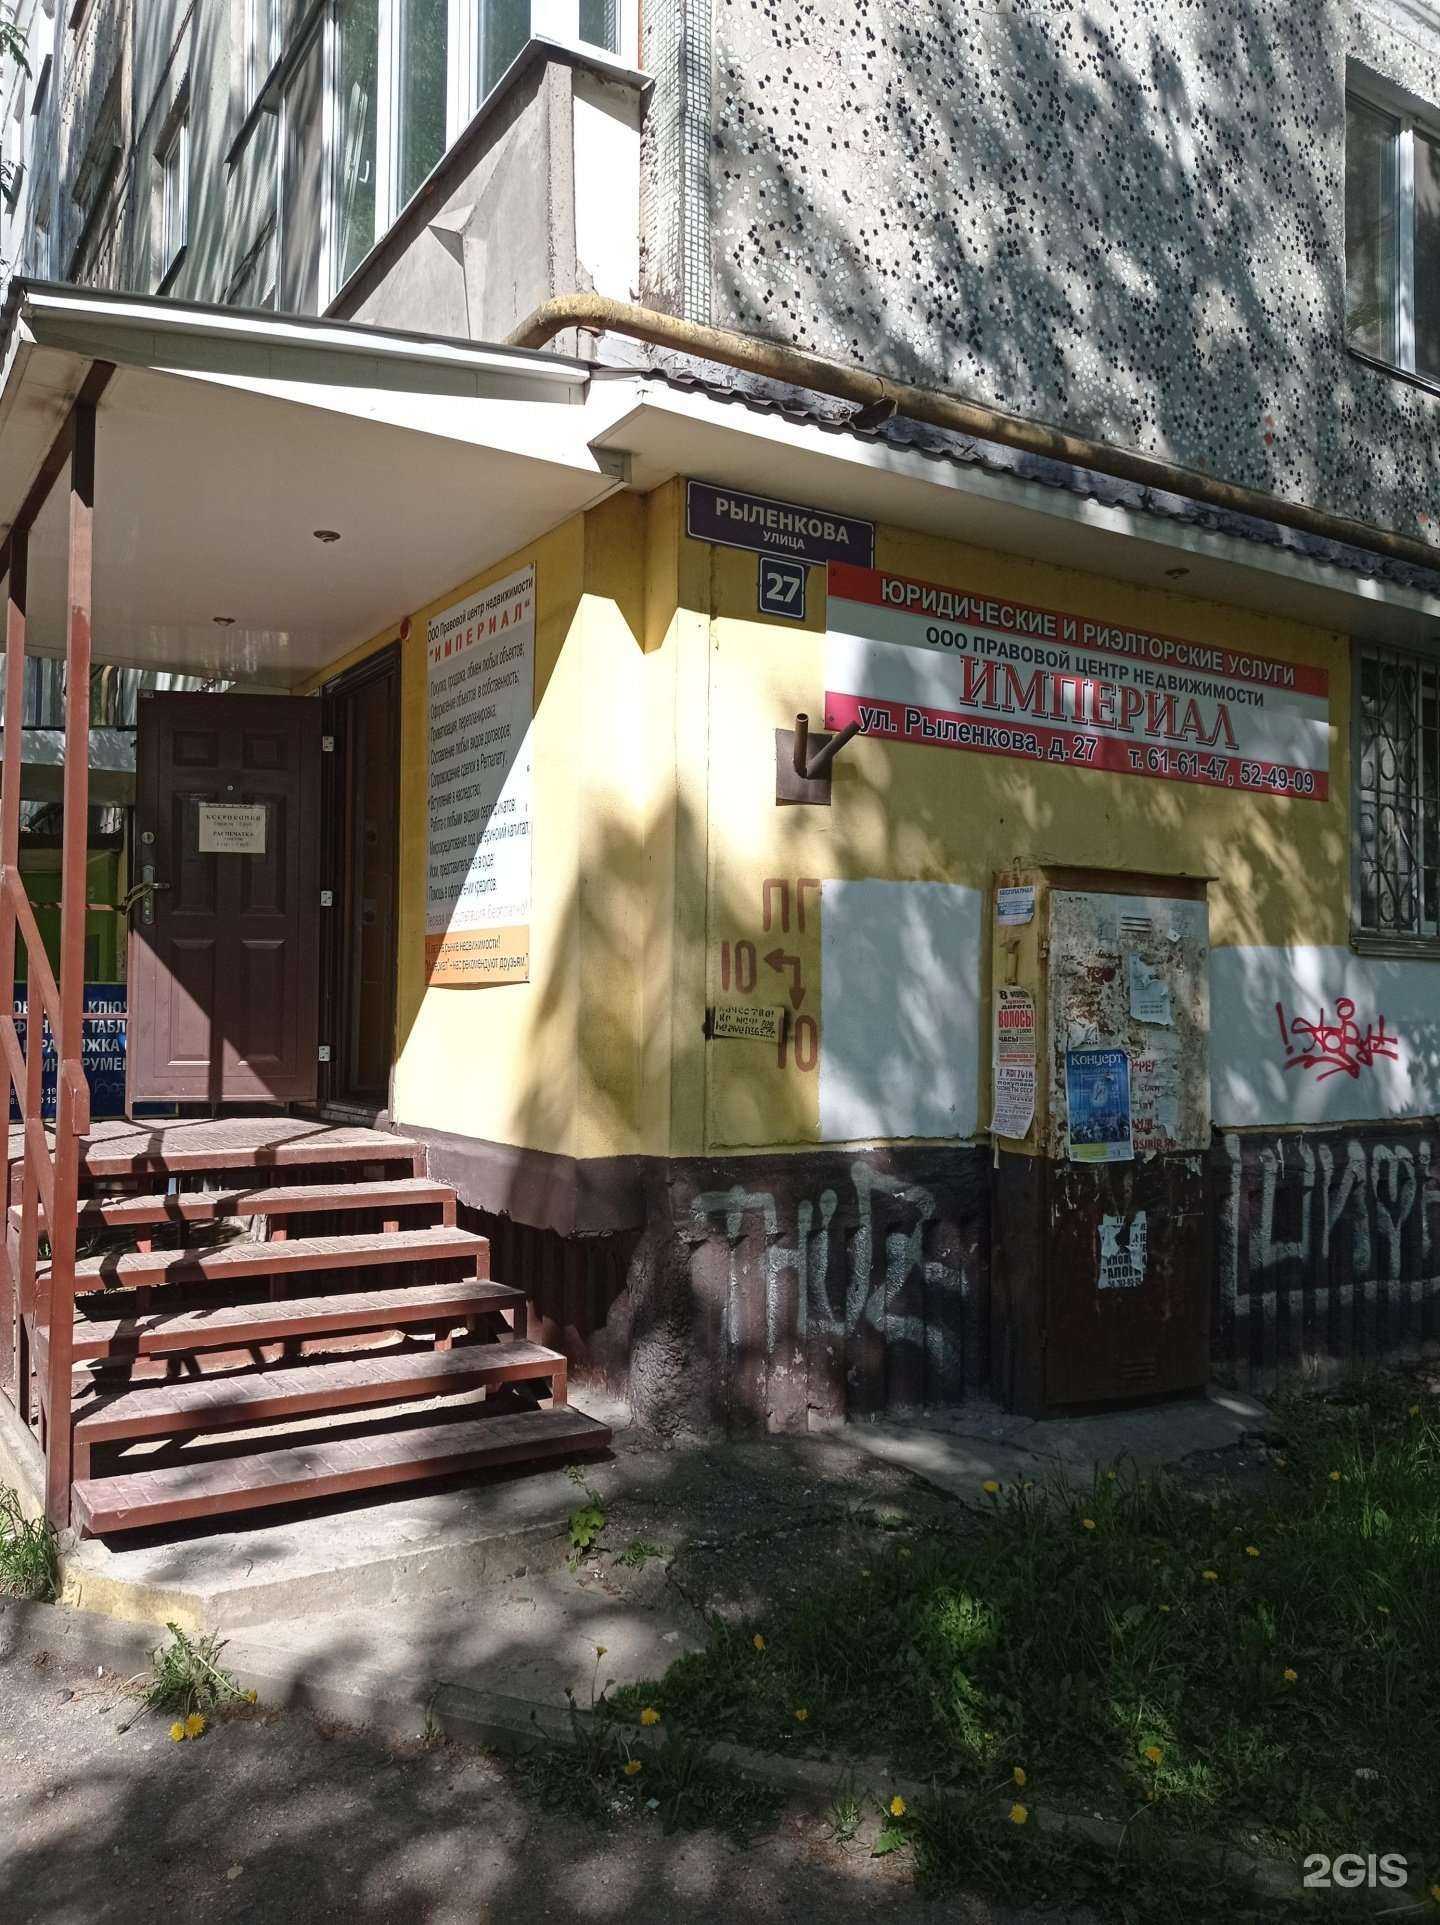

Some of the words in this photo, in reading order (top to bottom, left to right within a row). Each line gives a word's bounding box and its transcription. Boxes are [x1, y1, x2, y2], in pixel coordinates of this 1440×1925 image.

[716, 497, 850, 544] РЫЛЕНКОВА
[762, 530, 805, 550] УЛИЦА
[428, 625, 440, 643] ООО
[440, 612, 466, 639] Правовой
[467, 602, 485, 622] центр
[485, 577, 533, 611] недвижимости
[766, 572, 801, 603] 27
[881, 578, 1057, 637] ЮРИДИЧЕСКИЕ
[1063, 619, 1077, 641] И
[1083, 623, 1223, 673] РИЭЛТОРСКИЕ
[1229, 653, 1295, 687] УСЛУГИ
[926, 626, 968, 650] ООО
[973, 636, 1070, 670] ПРАВОВОЙ
[1075, 655, 1129, 681] ЦЕНТР
[1133, 667, 1264, 707] НЕДВИЖИМОСТИ
[959, 654, 1240, 750] ИМПЕРИАЛ
[858, 705, 897, 734] ул.
[904, 708, 1044, 758] Рыленкова,
[1048, 736, 1069, 762] д.
[1072, 735, 1098, 762] 27
[1128, 749, 1143, 769] т.
[1146, 748, 1234, 787] 61-61-47,
[1240, 763, 1315, 794] 52-49-09
[762, 878, 821, 933] ПГ
[721, 939, 758, 994] 10
[1071, 1053, 1122, 1066] Концерт
